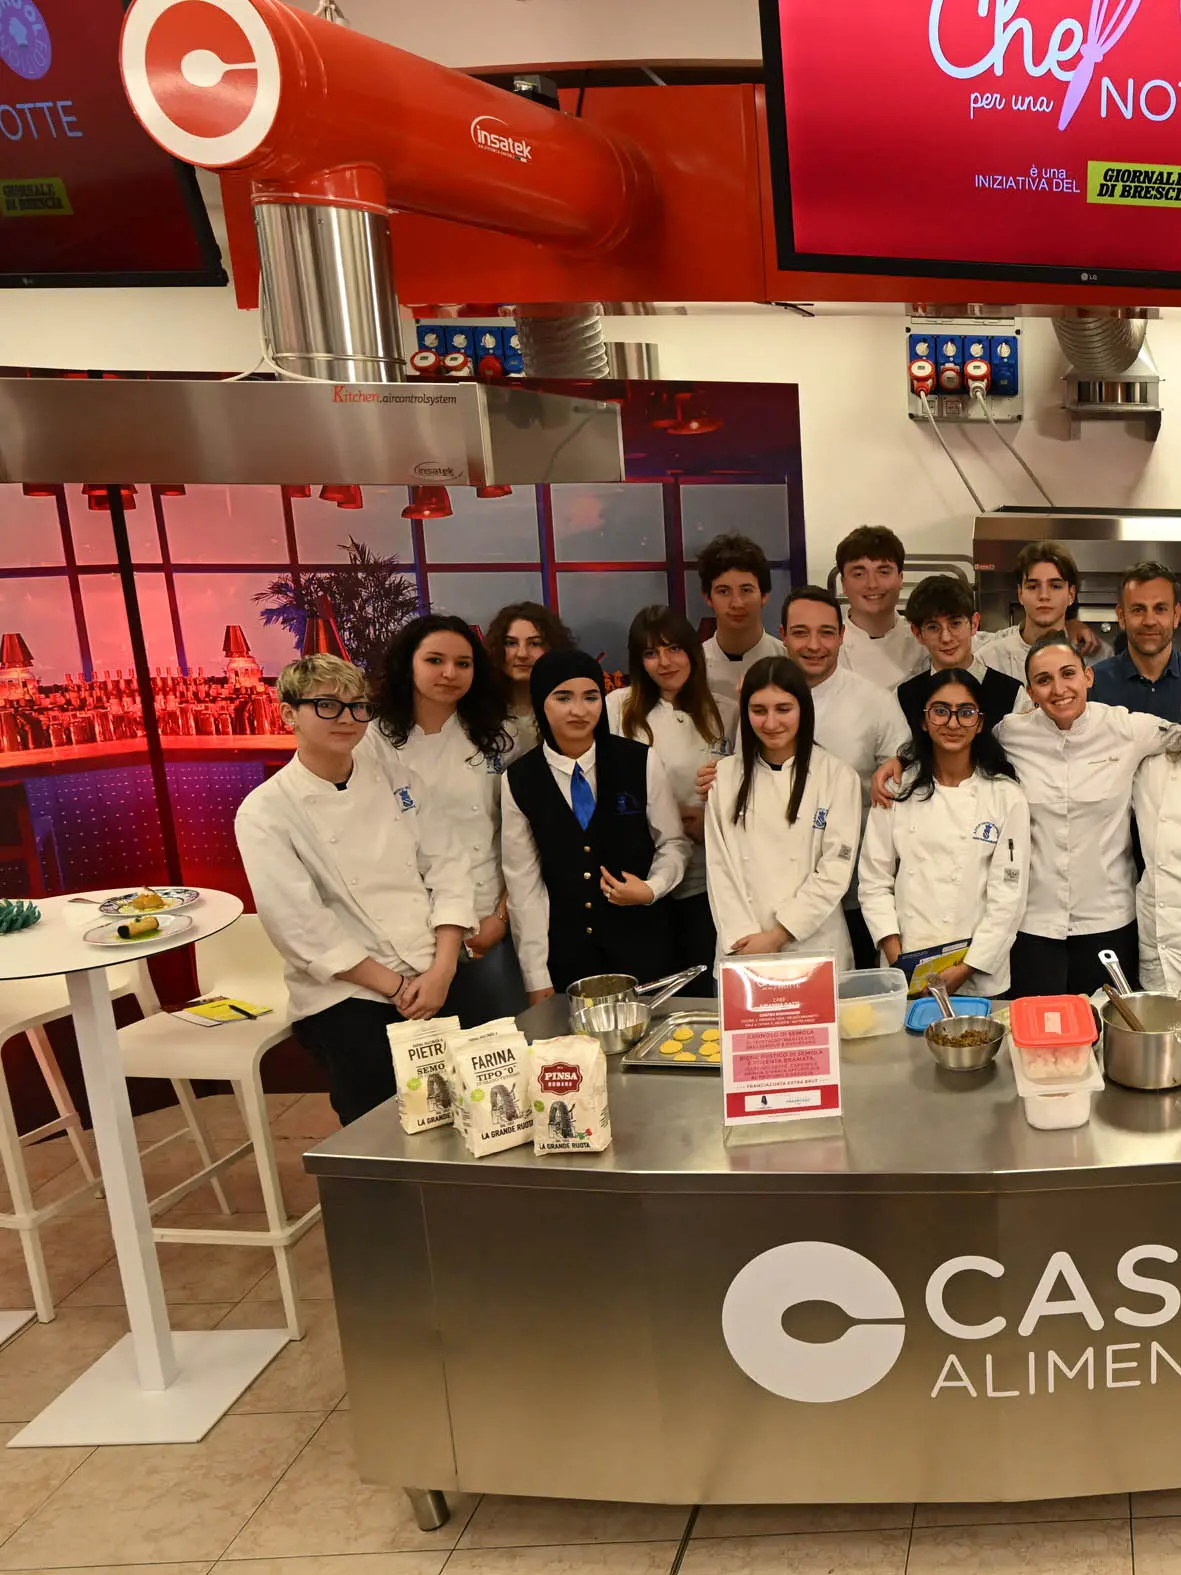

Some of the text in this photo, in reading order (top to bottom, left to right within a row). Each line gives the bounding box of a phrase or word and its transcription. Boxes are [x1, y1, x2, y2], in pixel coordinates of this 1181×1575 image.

[969, 90, 1054, 120] per una
[476, 124, 532, 160] insatek
[1029, 164, 1067, 180] è una
[975, 174, 1081, 194] INIZIATIVA DEL
[1096, 183, 1116, 198] DI
[471, 1048, 516, 1071] FARINA
[476, 1070, 503, 1082] TIPO
[544, 1071, 578, 1081] PINSA
[417, 1112, 451, 1127] LA GRANDE
[481, 1132, 490, 1141] LA
[491, 1124, 517, 1139] GRANDE
[539, 1141, 591, 1150] LA GRANDE RUOTA
